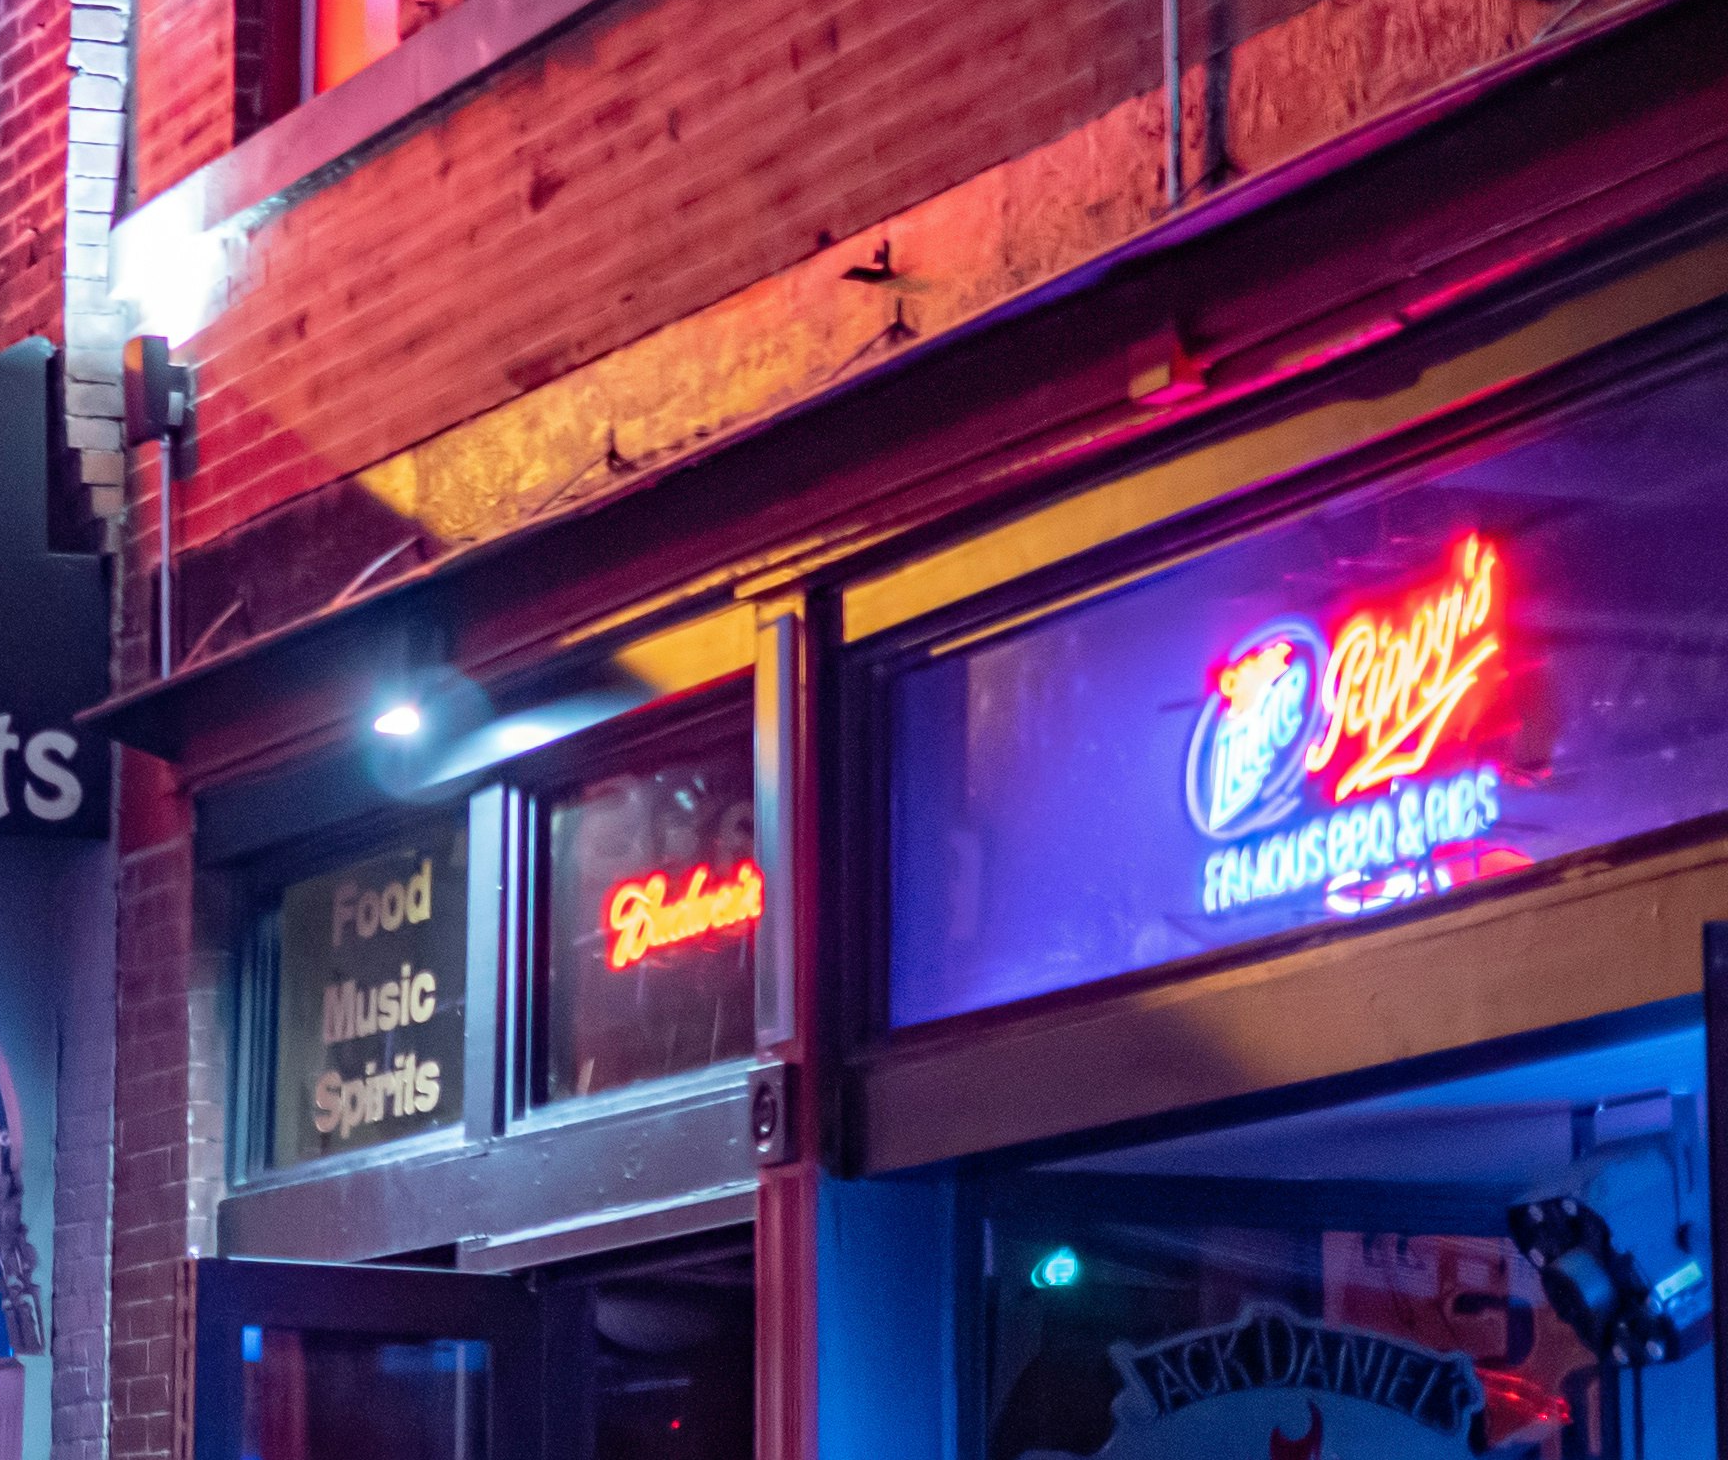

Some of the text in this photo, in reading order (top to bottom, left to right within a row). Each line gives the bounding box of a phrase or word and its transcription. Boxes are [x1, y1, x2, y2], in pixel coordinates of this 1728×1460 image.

[333, 859, 433, 947] Food
[323, 961, 436, 1043] Music
[314, 1052, 441, 1139] Spirits
